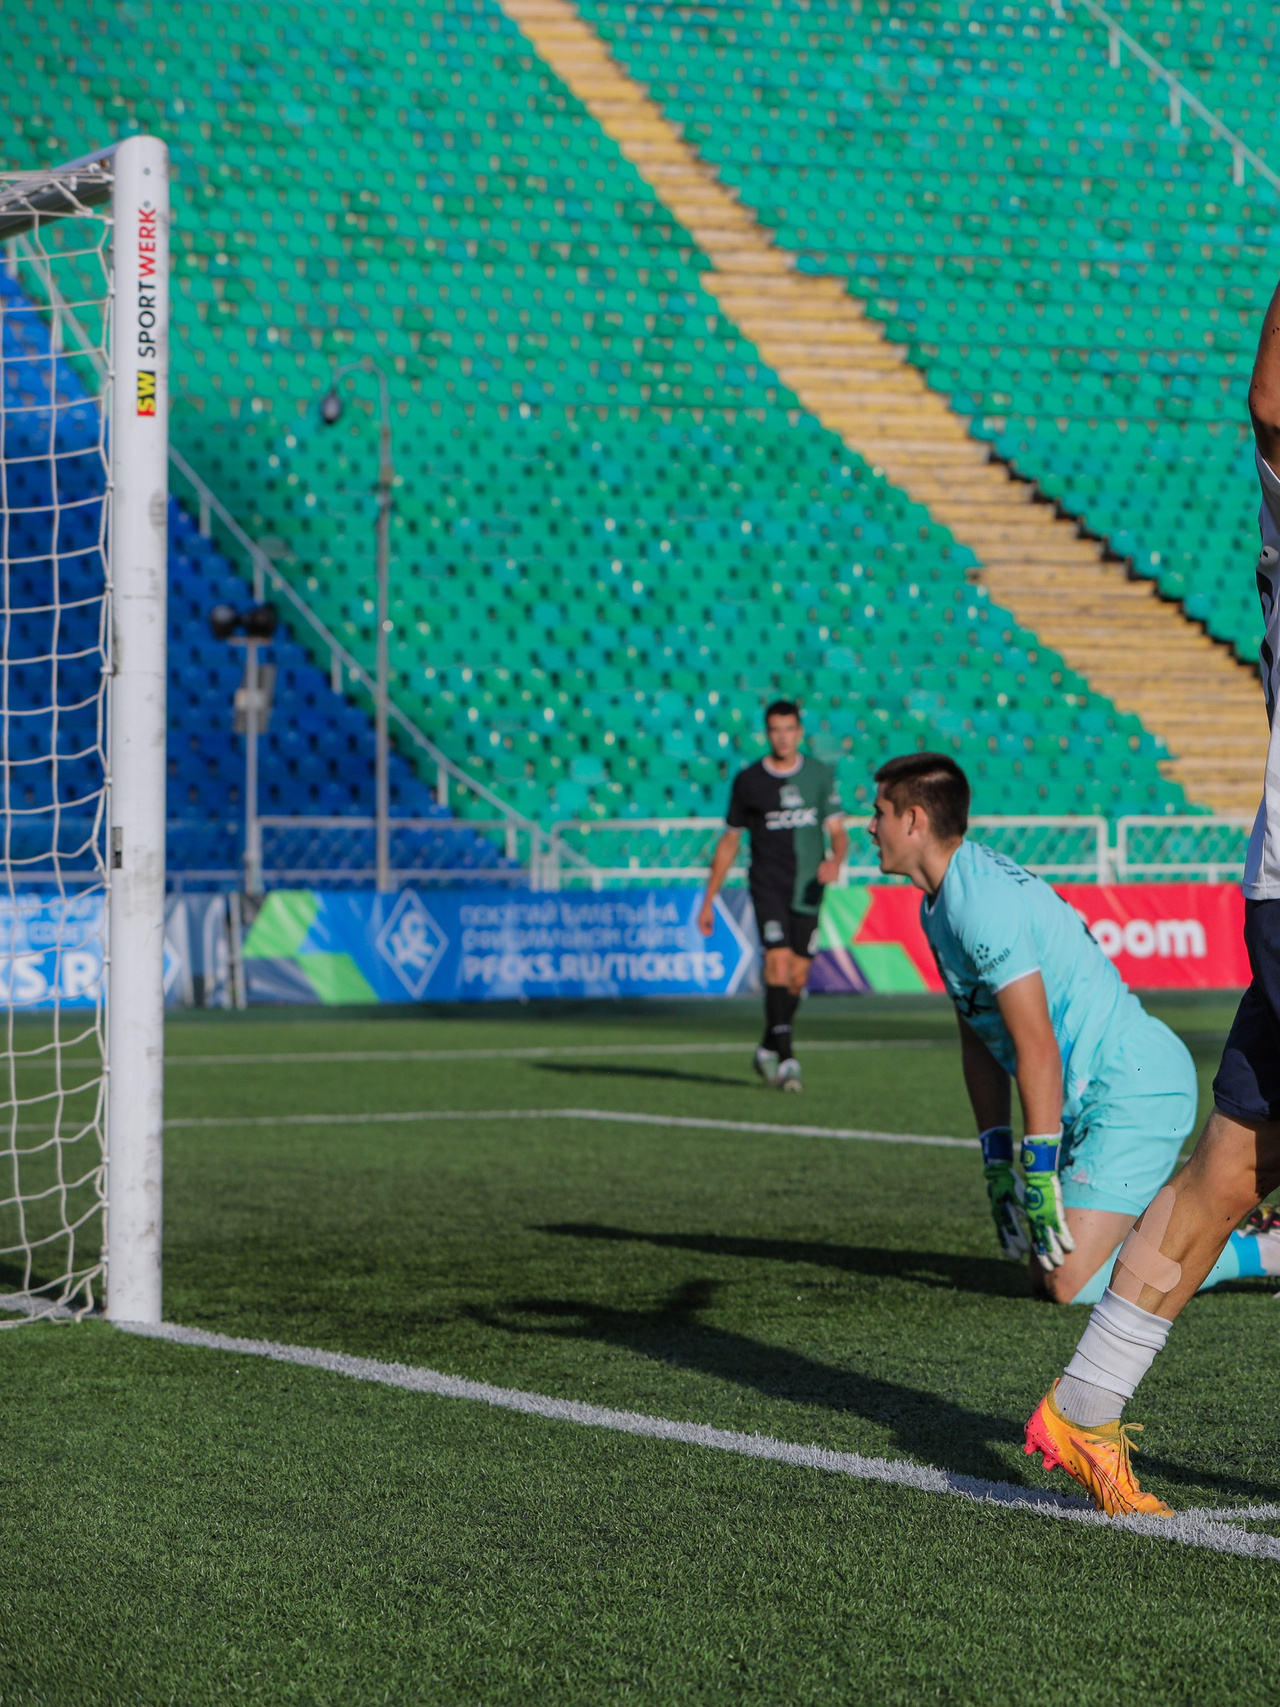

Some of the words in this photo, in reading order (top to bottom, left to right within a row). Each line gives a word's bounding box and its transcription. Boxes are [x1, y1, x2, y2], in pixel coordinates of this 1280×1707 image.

[137, 370, 156, 412] SW
[1076, 909, 1209, 960] oom
[463, 951, 726, 983] PFCKS.RU/TICKETS
